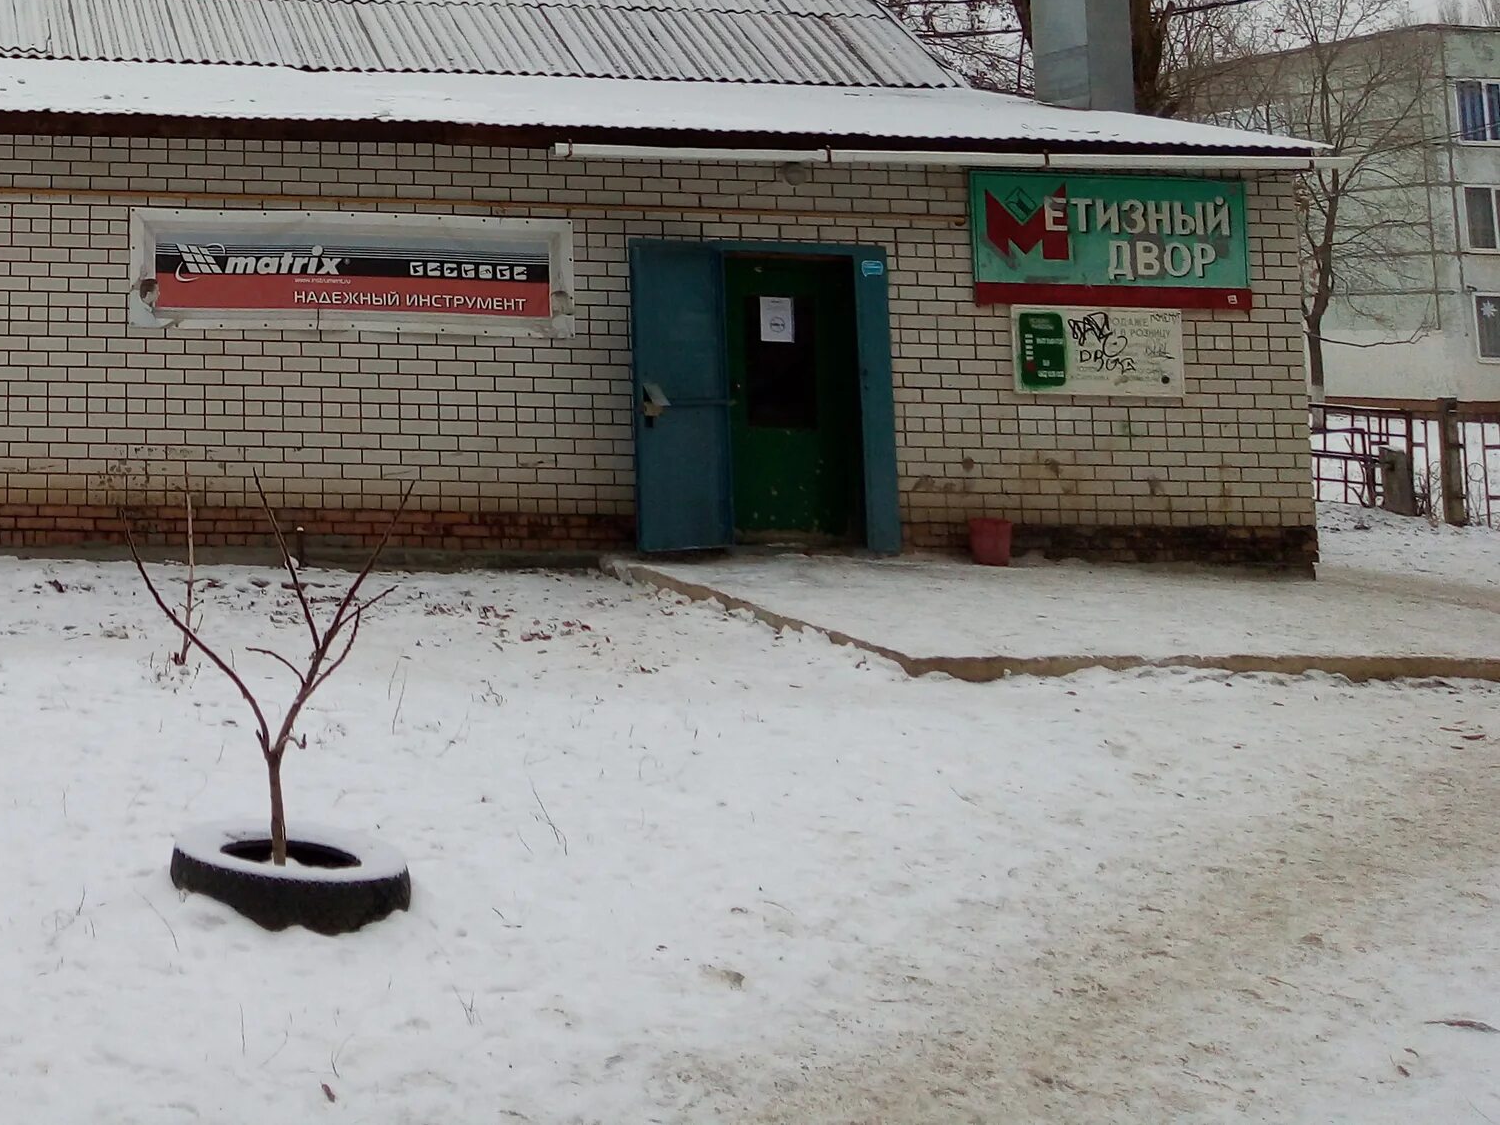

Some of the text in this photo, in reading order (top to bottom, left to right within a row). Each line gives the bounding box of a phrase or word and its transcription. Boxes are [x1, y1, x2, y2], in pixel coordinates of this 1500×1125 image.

[984, 181, 1230, 261] МЕТИЗНЫЙ
[225, 245, 342, 275] matrix
[1108, 241, 1217, 281] ДВОР
[293, 289, 527, 312] НАДЕЖНЫЙ ИНСТРУМЕНТ
